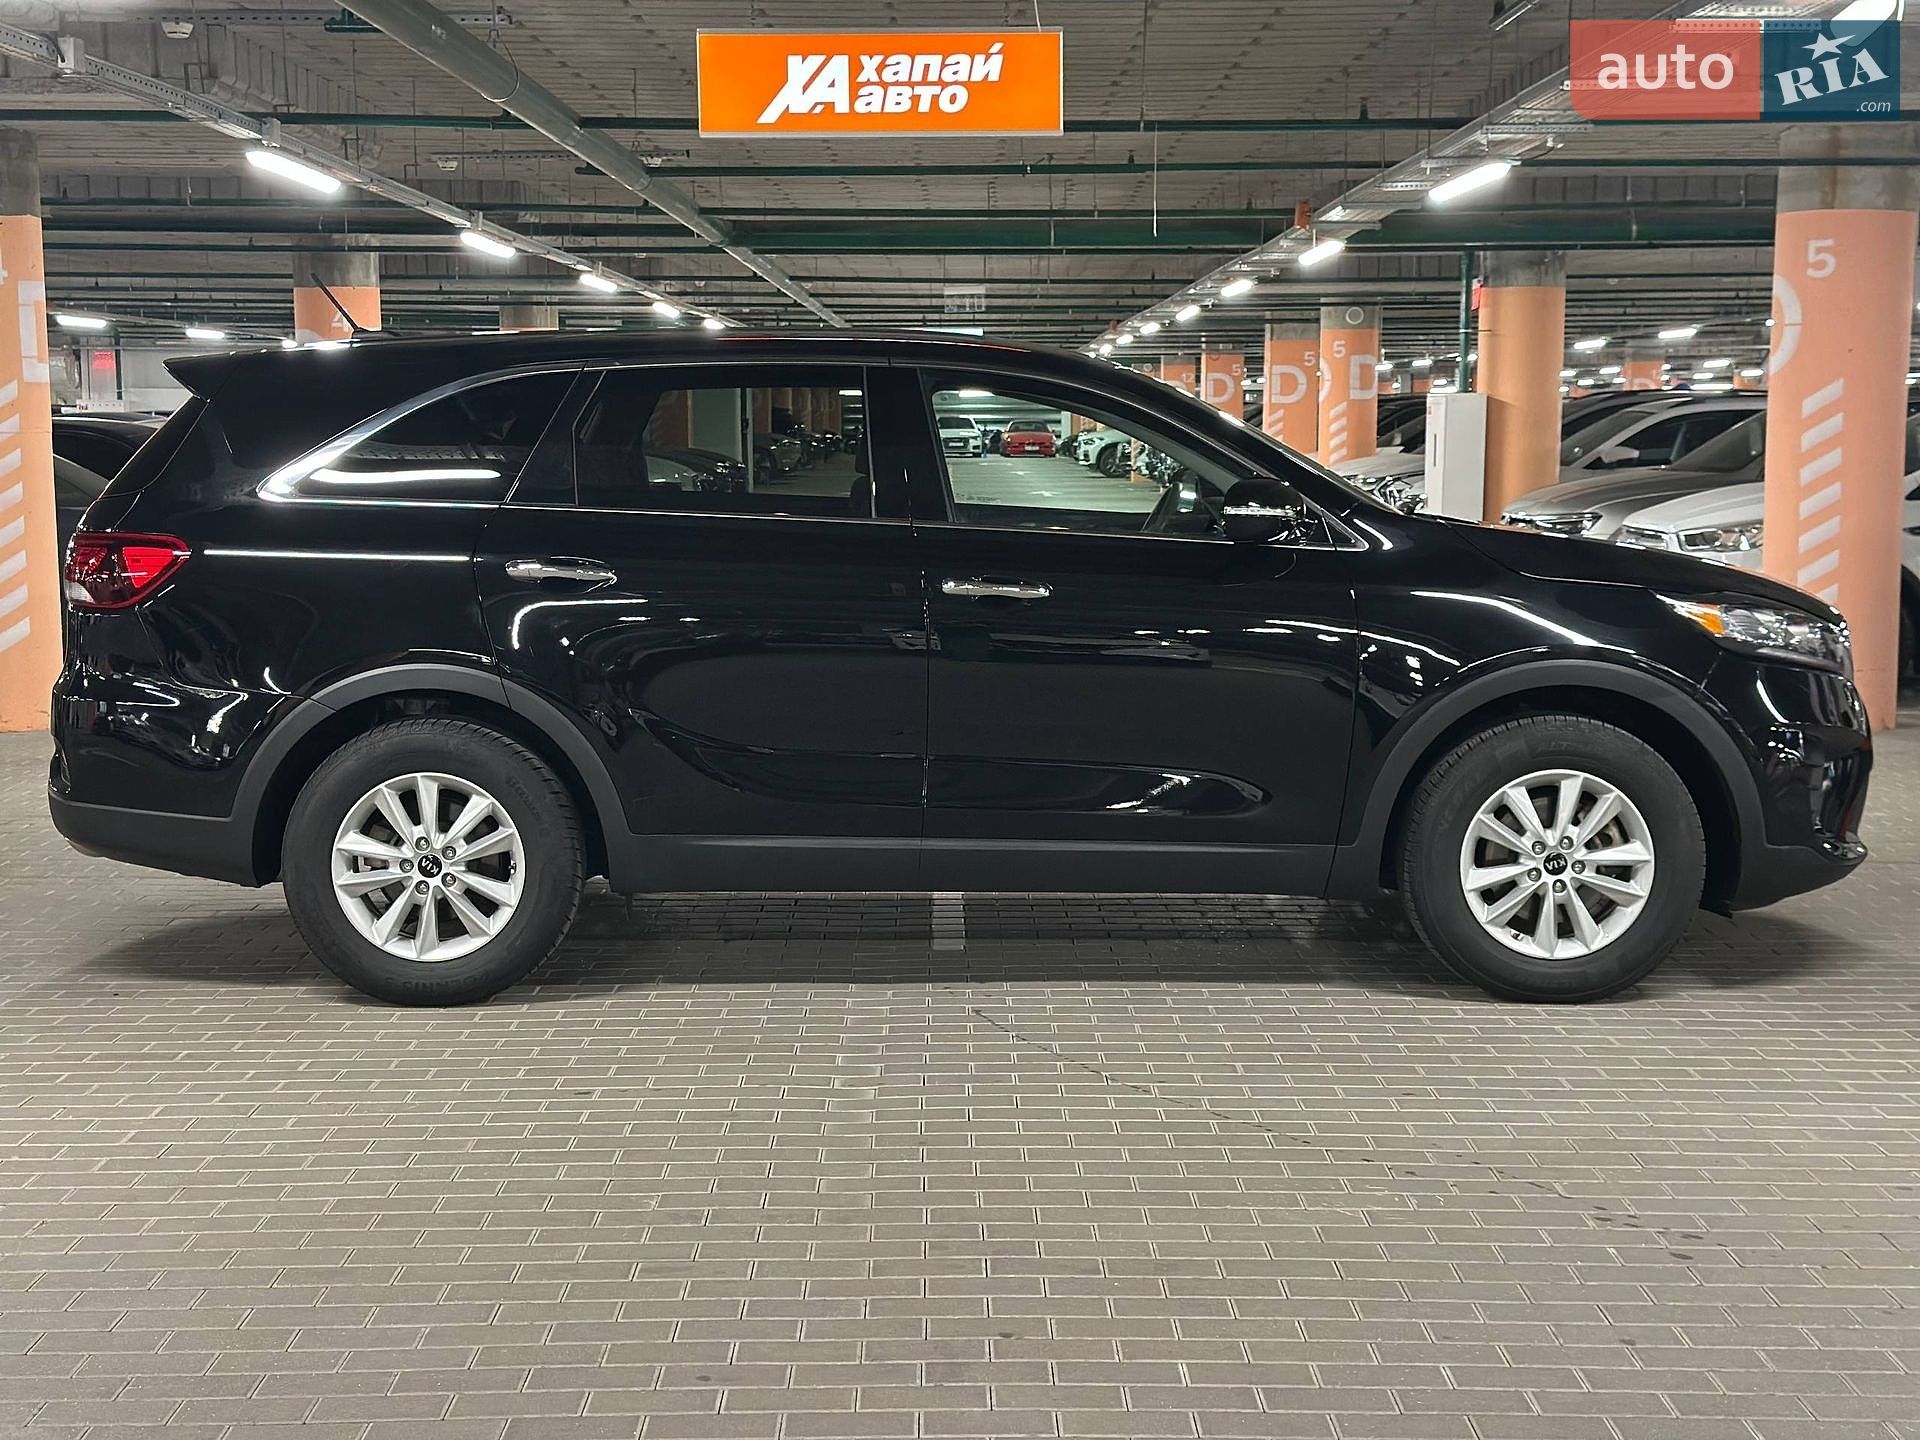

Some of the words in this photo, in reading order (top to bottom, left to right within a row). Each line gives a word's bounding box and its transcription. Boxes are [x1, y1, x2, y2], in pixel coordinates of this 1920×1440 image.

[856, 42, 1005, 83] хапай
[854, 84, 969, 113] авто
[1806, 239, 1837, 278] 5
[1333, 340, 1346, 358] 5
[1206, 372, 1235, 403] D
[1231, 364, 1241, 376] 5
[1271, 364, 1307, 404] D
[1304, 351, 1315, 366] 5
